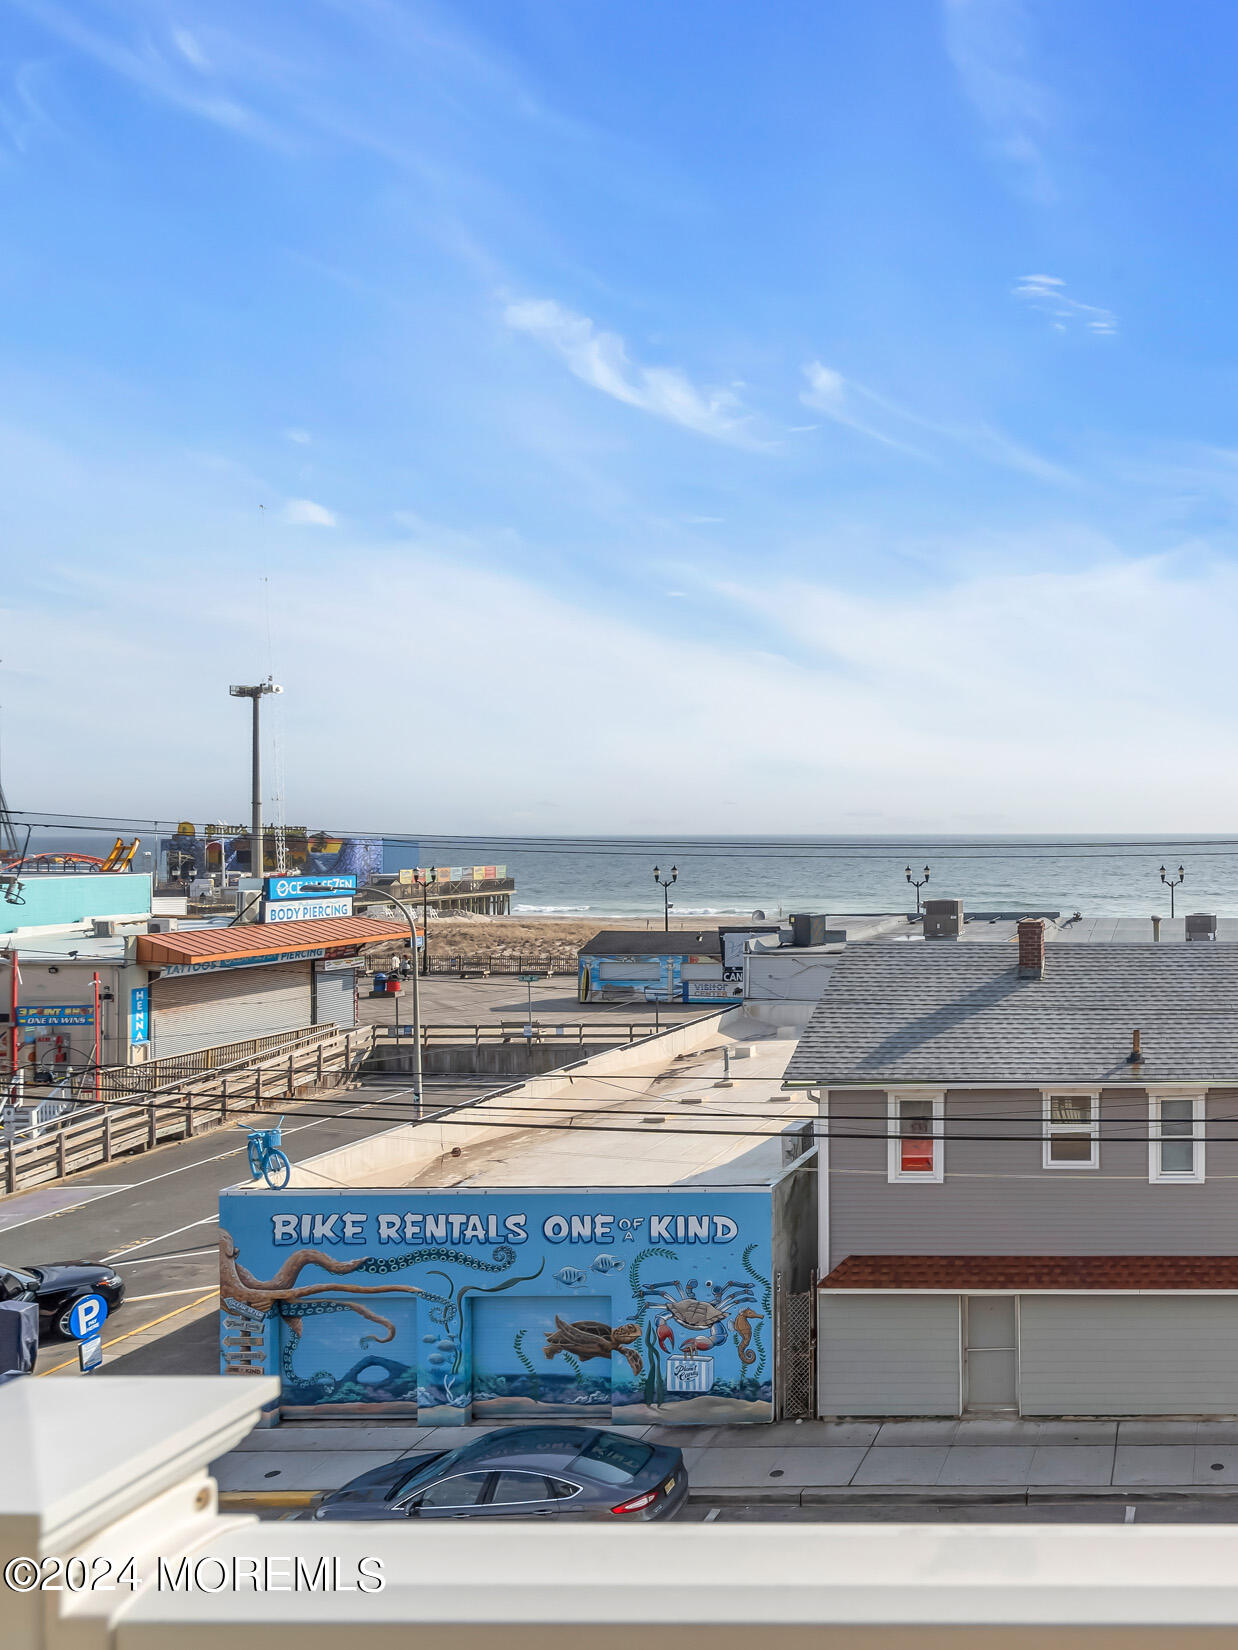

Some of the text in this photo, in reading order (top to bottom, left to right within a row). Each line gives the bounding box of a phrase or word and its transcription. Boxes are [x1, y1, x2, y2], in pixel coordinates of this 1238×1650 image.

[270, 907, 301, 921] BODY
[302, 903, 348, 919] PIERCING
[280, 948, 323, 961] PIERCING
[135, 991, 144, 1041] HENNA
[271, 1212, 739, 1246] BIKE RENTALS ONE OF A KIND
[78, 1299, 100, 1335] P
